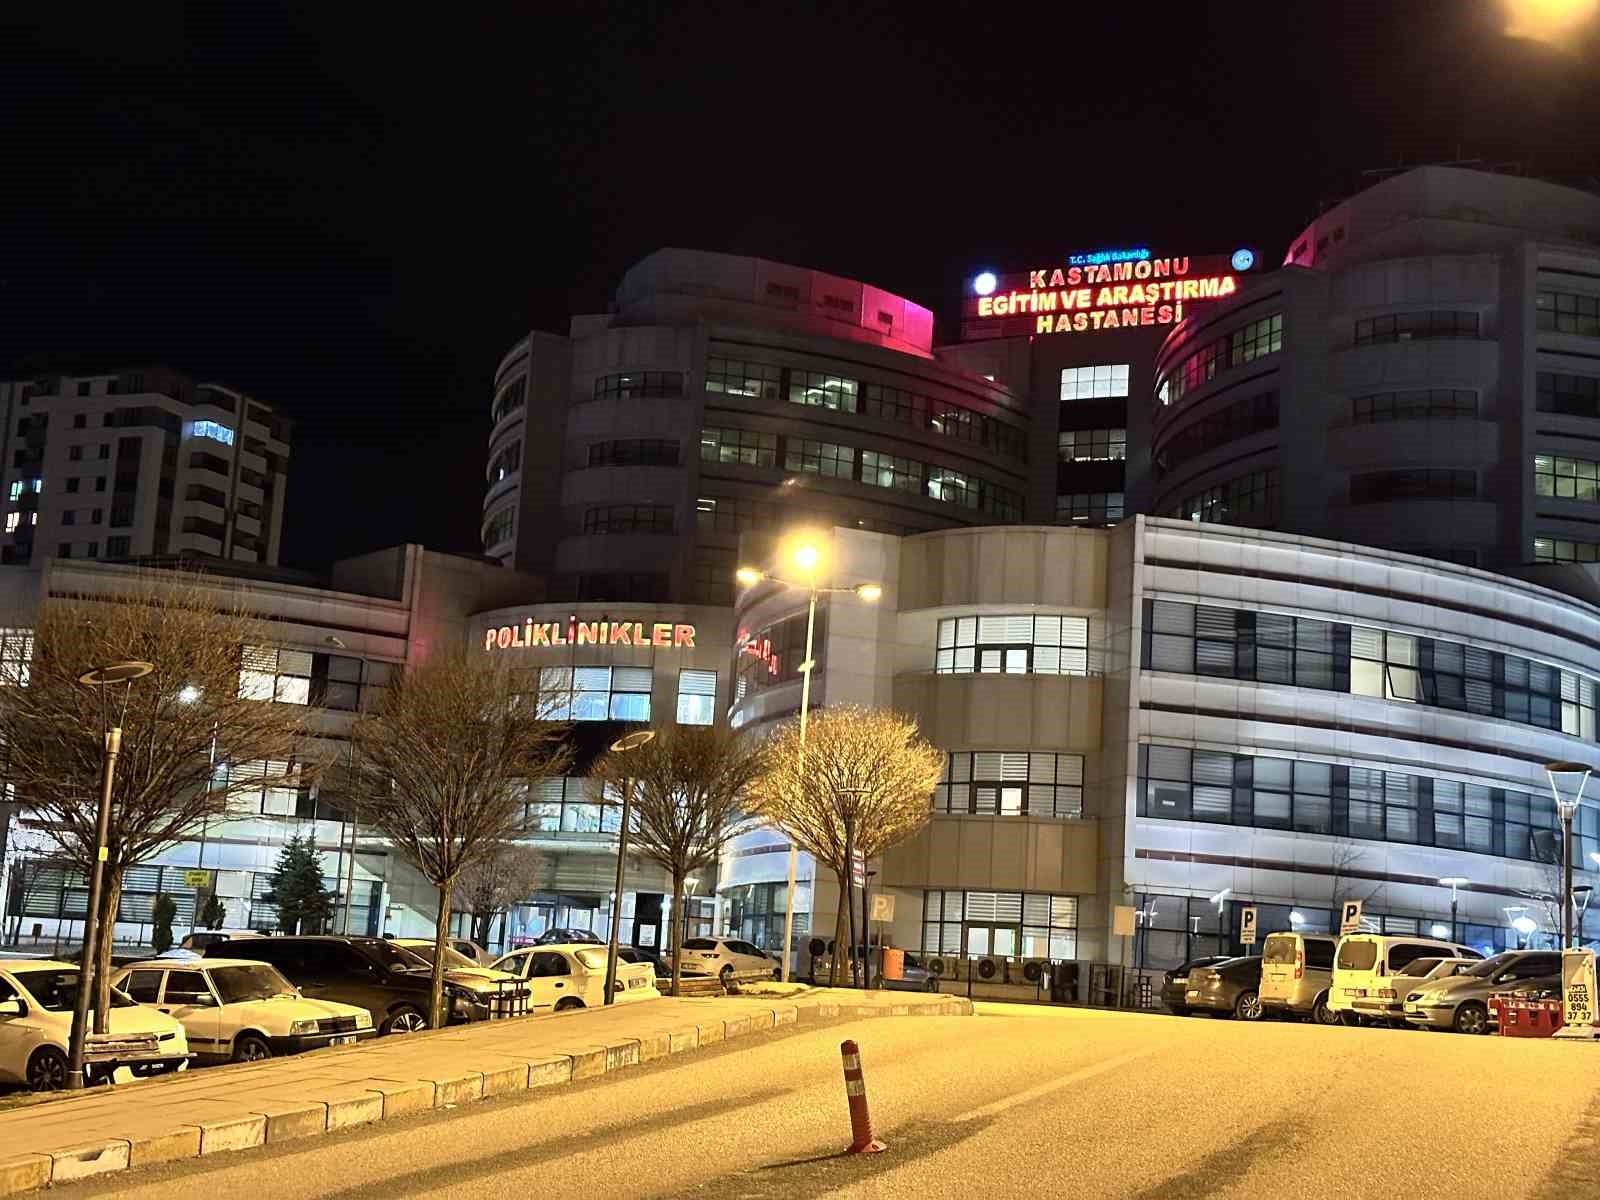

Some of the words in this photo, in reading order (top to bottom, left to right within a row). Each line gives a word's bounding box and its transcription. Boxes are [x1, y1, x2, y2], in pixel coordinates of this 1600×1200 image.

[1030, 256, 1190, 289] KASTAMONU
[1060, 289, 1092, 310] VE
[1096, 276, 1236, 305] ARAŞTIRMA
[1036, 301, 1182, 334] HASTANESİ
[873, 898, 887, 918] P
[1345, 905, 1357, 923] P
[1244, 910, 1254, 928] P
[1568, 994, 1589, 1002] 0555
[1571, 1003, 1587, 1011] 894
[1568, 1012, 1577, 1020] 37
[1581, 1012, 1591, 1020] 37
